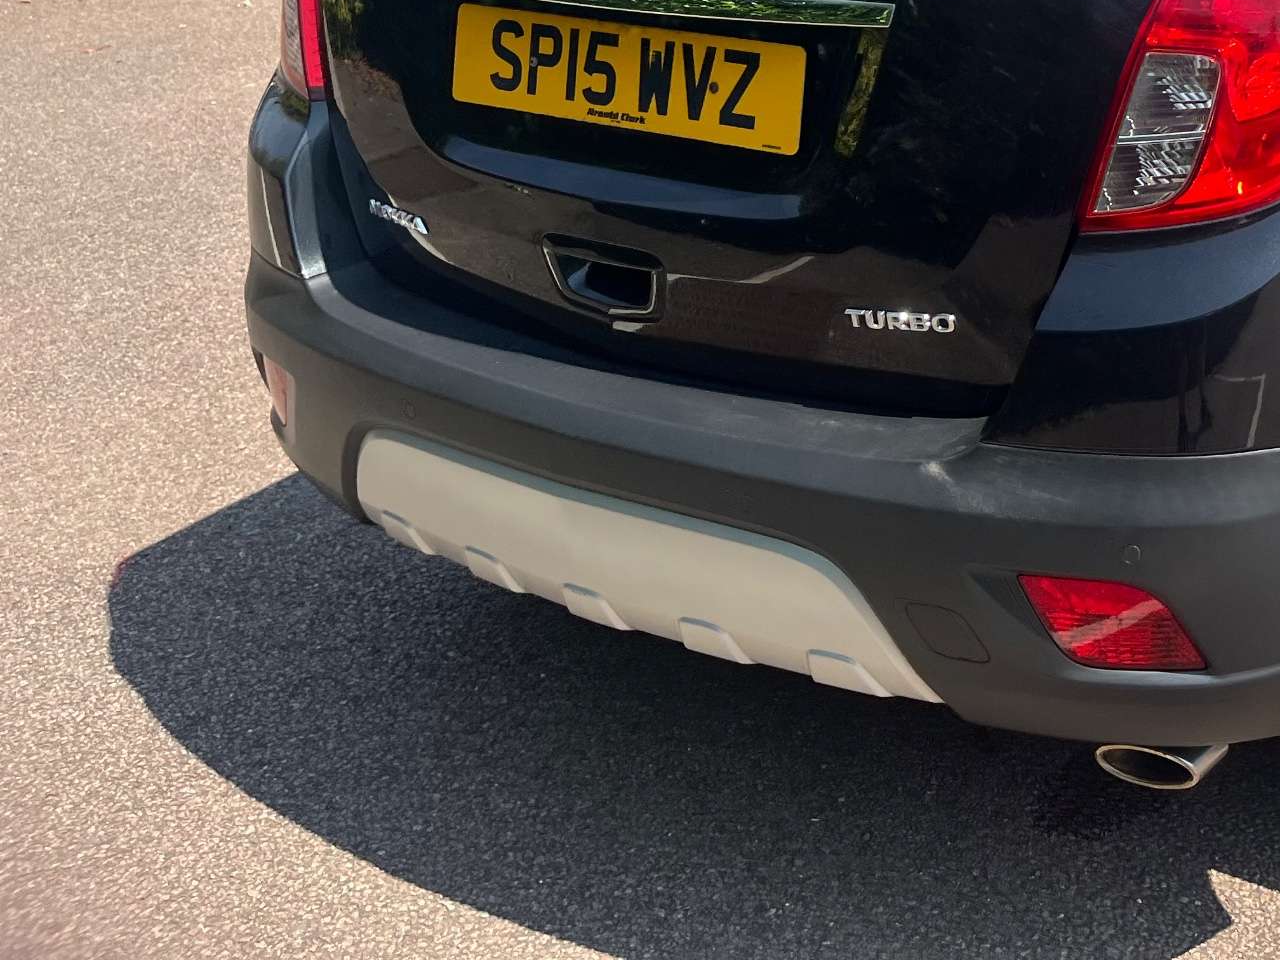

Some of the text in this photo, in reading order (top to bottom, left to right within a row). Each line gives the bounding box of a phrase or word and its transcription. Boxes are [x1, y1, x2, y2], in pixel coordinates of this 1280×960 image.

[489, 19, 761, 130] SP15 WVZ
[844, 308, 957, 333] TURBO
